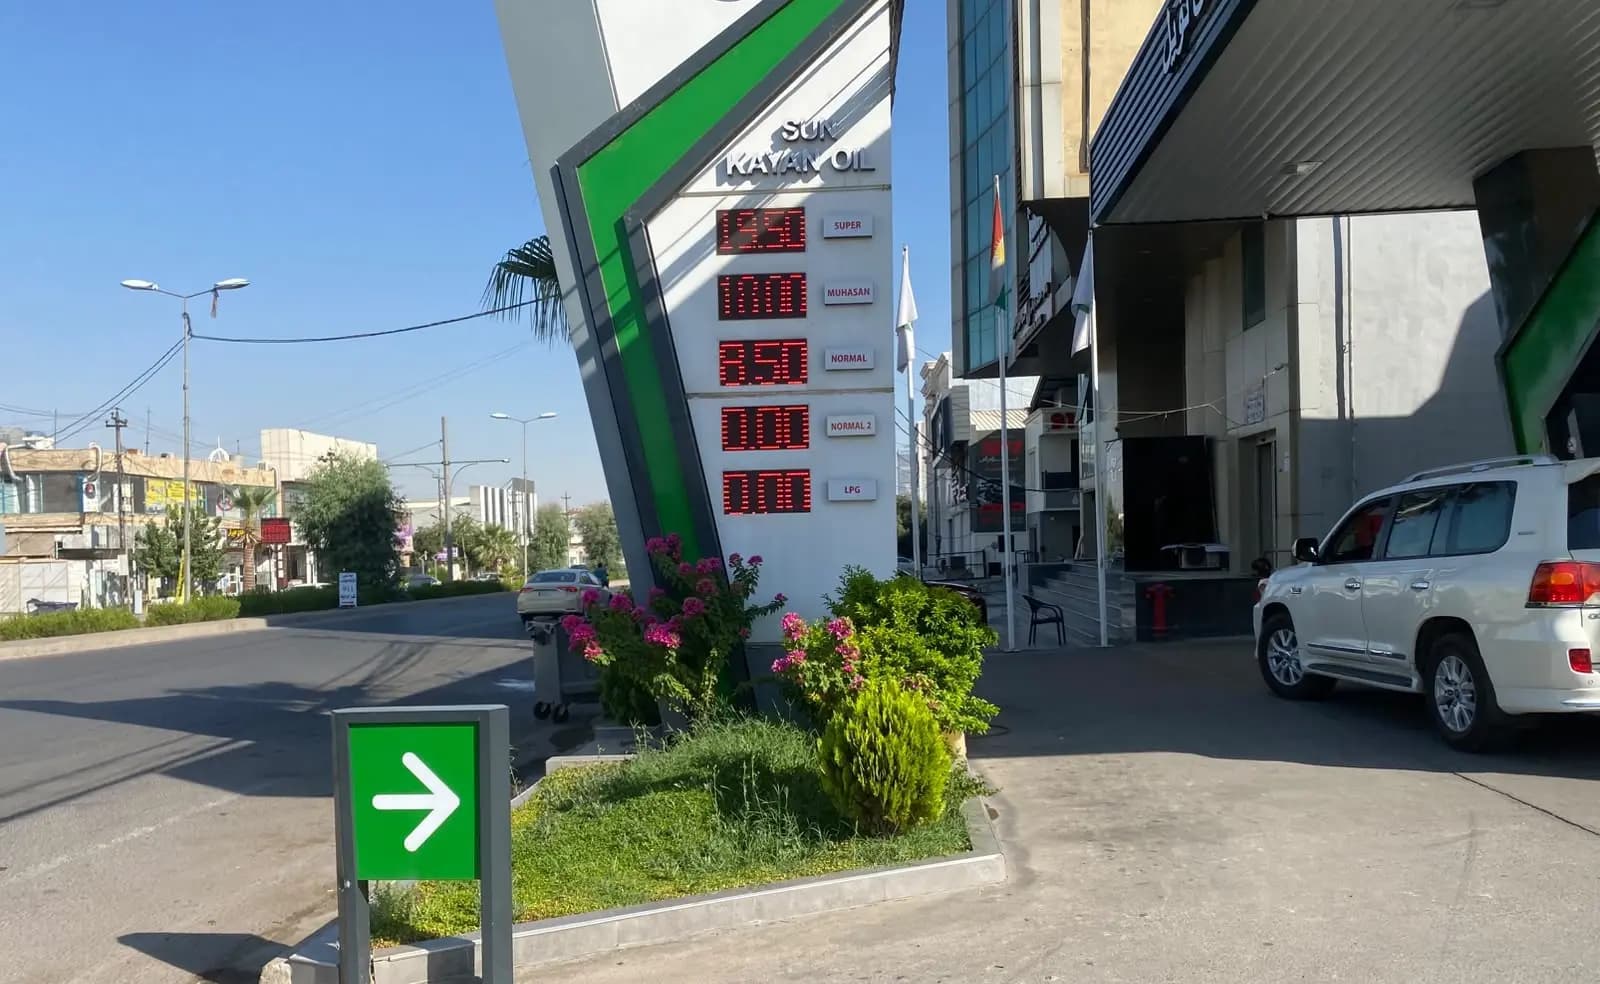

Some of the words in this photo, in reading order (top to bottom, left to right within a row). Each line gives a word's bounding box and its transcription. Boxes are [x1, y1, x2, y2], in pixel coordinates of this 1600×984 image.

[782, 119, 838, 142] SUN
[726, 150, 821, 176] KAYAN
[831, 148, 876, 172] OIL
[833, 220, 862, 231] SUPER
[827, 287, 871, 298] MUHASAN
[831, 354, 867, 364] NORMAL
[831, 422, 865, 431] NORMAL
[866, 421, 872, 430] 2
[844, 486, 861, 494] LPG
